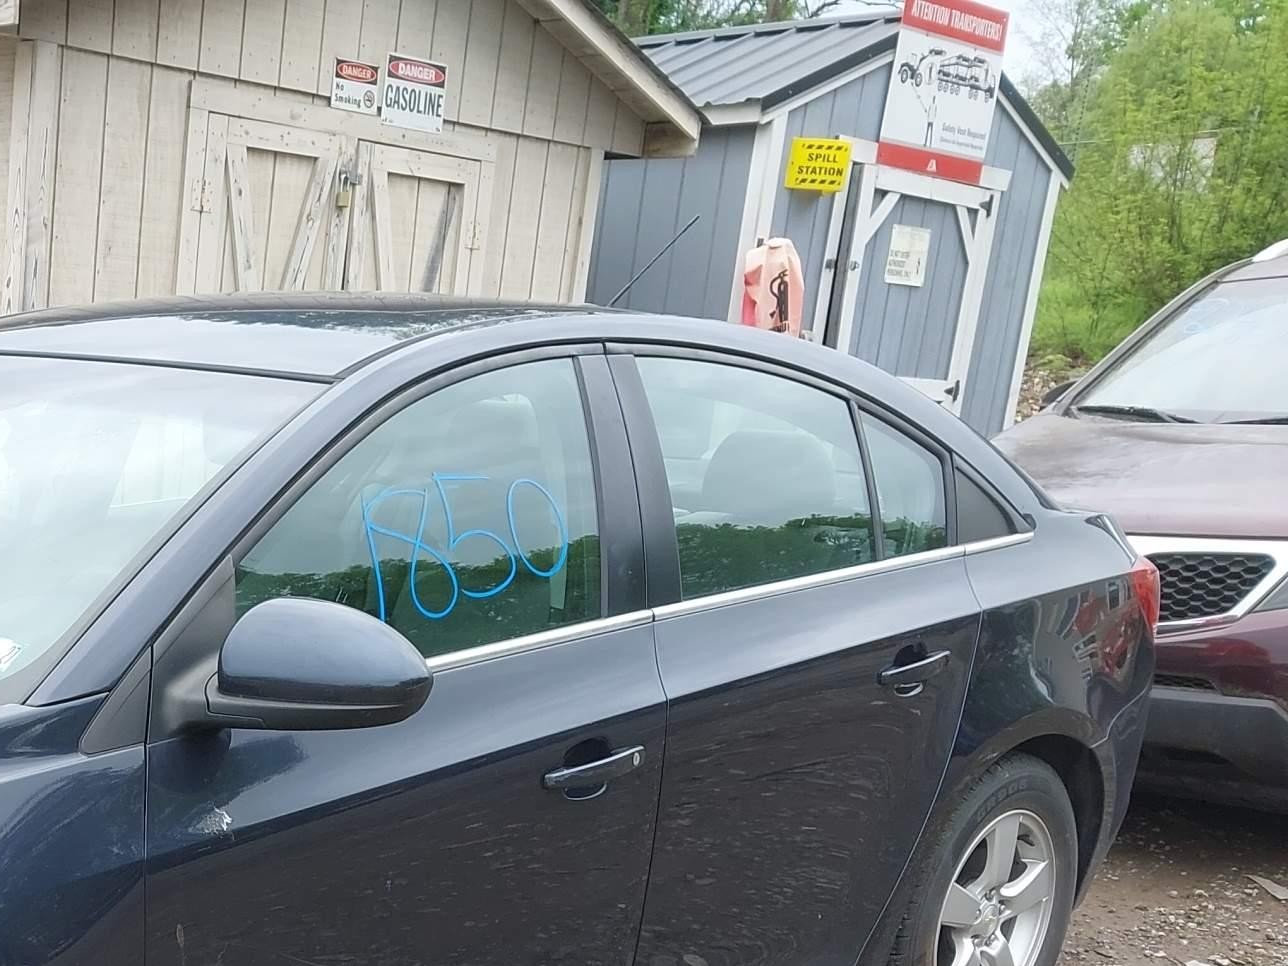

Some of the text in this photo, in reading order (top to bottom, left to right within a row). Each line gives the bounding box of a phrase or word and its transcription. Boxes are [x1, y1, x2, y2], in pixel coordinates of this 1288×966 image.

[911, 0, 1003, 41] ATTENTION TRANSPORTERS!
[342, 64, 372, 79] DANGER
[398, 62, 435, 81] DANGER
[335, 82, 345, 91] No
[334, 94, 362, 109] Smoking
[385, 84, 444, 118] GASOLINE
[808, 152, 838, 163] SPILL
[797, 166, 844, 177] STATION
